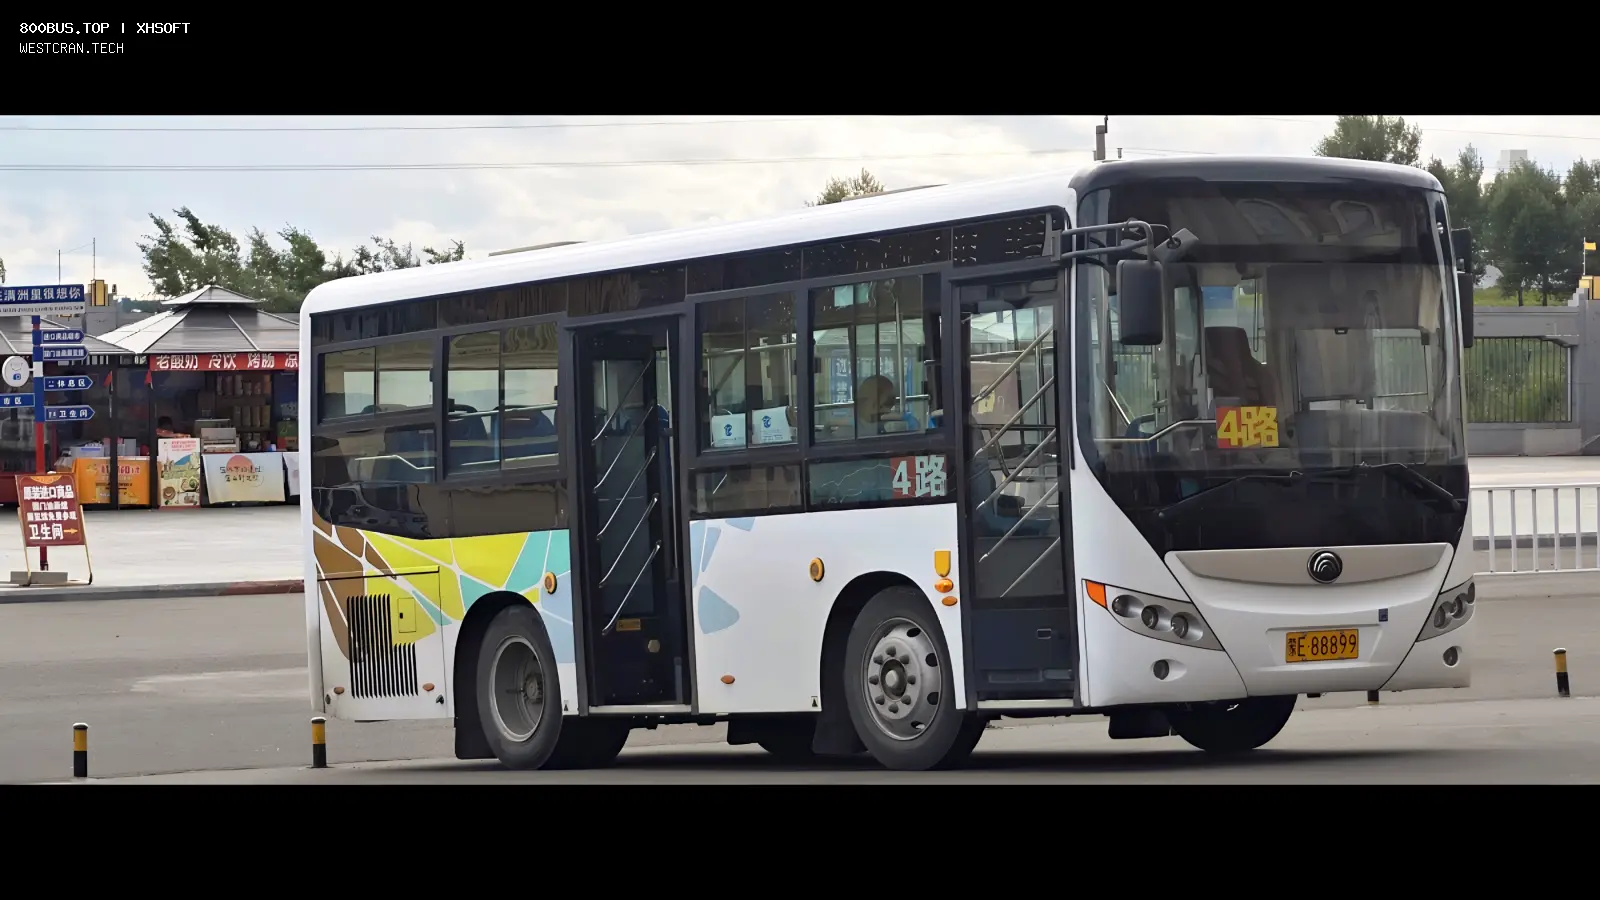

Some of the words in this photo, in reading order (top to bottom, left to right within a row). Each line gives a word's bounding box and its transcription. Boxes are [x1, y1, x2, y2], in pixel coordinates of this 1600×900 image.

[156, 354, 199, 369] 老酸奶
[208, 353, 237, 370] 冷饮
[247, 352, 275, 369] 烤肠
[59, 409, 88, 418] 卫生间
[1217, 406, 1279, 448] 4路
[892, 454, 947, 498] 4路
[29, 522, 64, 540] 卫生间
